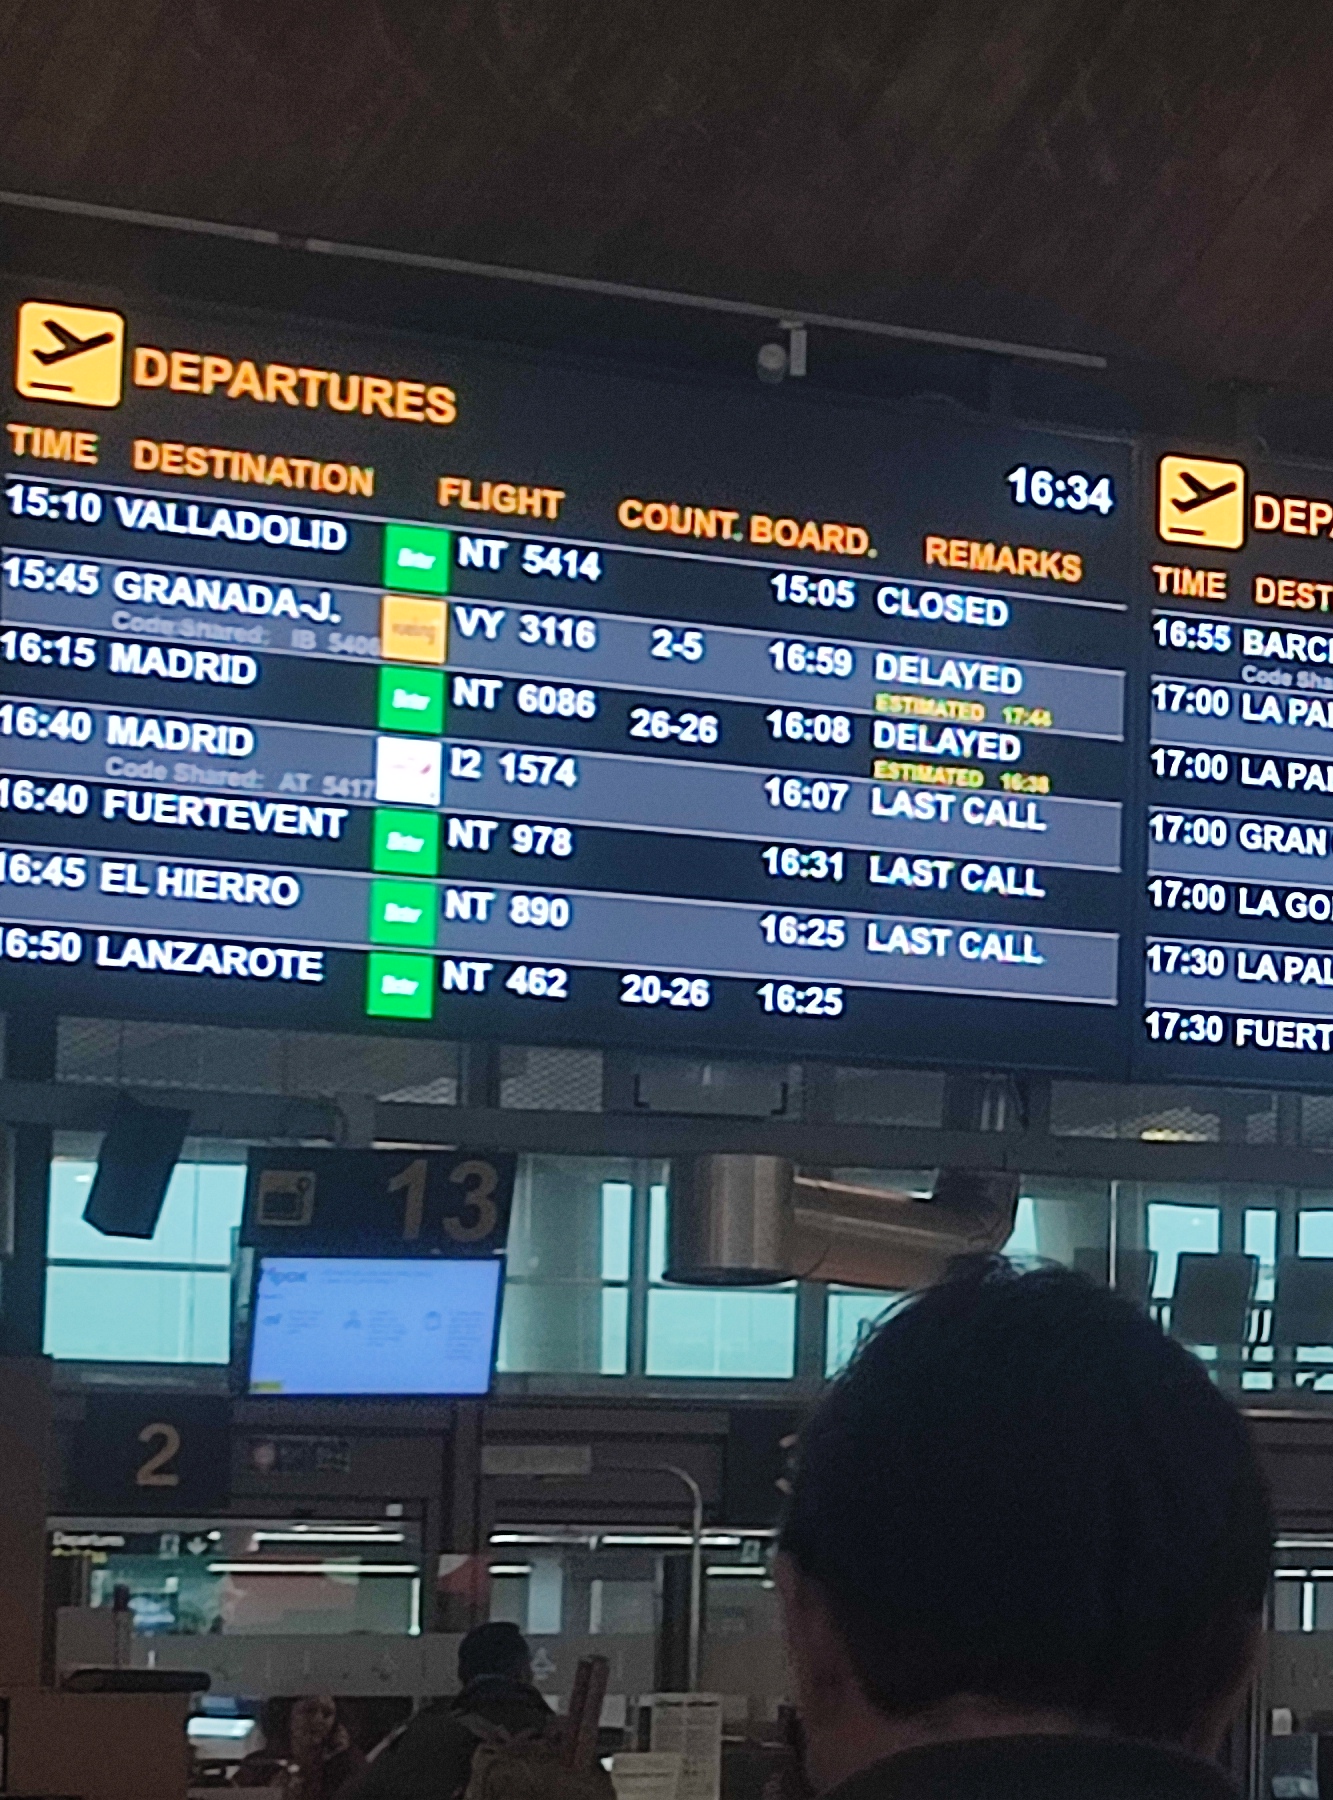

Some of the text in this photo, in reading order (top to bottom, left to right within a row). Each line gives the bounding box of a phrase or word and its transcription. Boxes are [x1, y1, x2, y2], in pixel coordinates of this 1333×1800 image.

[134, 347, 456, 423] DEPARTURES
[7, 424, 1081, 582] TIME DESTINATION FLIGHT COUNT. BOARD. REMARKS
[1008, 467, 1113, 514] 16:34
[6, 483, 102, 523] 15:10
[114, 496, 347, 551] VALLADOLID
[458, 536, 509, 570] NT
[522, 544, 601, 581] 5414
[771, 573, 855, 608] 15:05
[877, 586, 1009, 627] CLOSED
[1153, 565, 1226, 599] TIME
[3, 557, 100, 595] 15:45
[113, 570, 342, 624] GRANADA-J.
[455, 606, 506, 639] VY
[519, 614, 596, 649] 3116
[651, 628, 703, 661] 2-5
[769, 641, 853, 677] 16:59
[875, 652, 1023, 695] DELAYED
[1153, 618, 1231, 652] 16:55
[0, 630, 1021, 761] 16:15 MADRID NT 6086 26-26 16:08 DELAYED
[876, 693, 985, 722] ESTIMATED
[1241, 665, 1292, 686] Code
[0, 704, 1048, 831] 16:40 MADRID I2 1574 16:07 LAST CALL
[105, 756, 168, 781] Code
[279, 773, 314, 792] AT
[1149, 813, 1227, 847] 17:00
[1239, 822, 1327, 856] GRAN
[96, 935, 324, 982] LANZAROTE
[443, 959, 494, 992] NT
[506, 965, 567, 998] 462
[620, 973, 710, 1007] 20-26
[758, 982, 843, 1016] 16:25
[1145, 1010, 1223, 1042] 17:30
[386, 1158, 500, 1243] 13
[135, 1422, 181, 1487] 2
